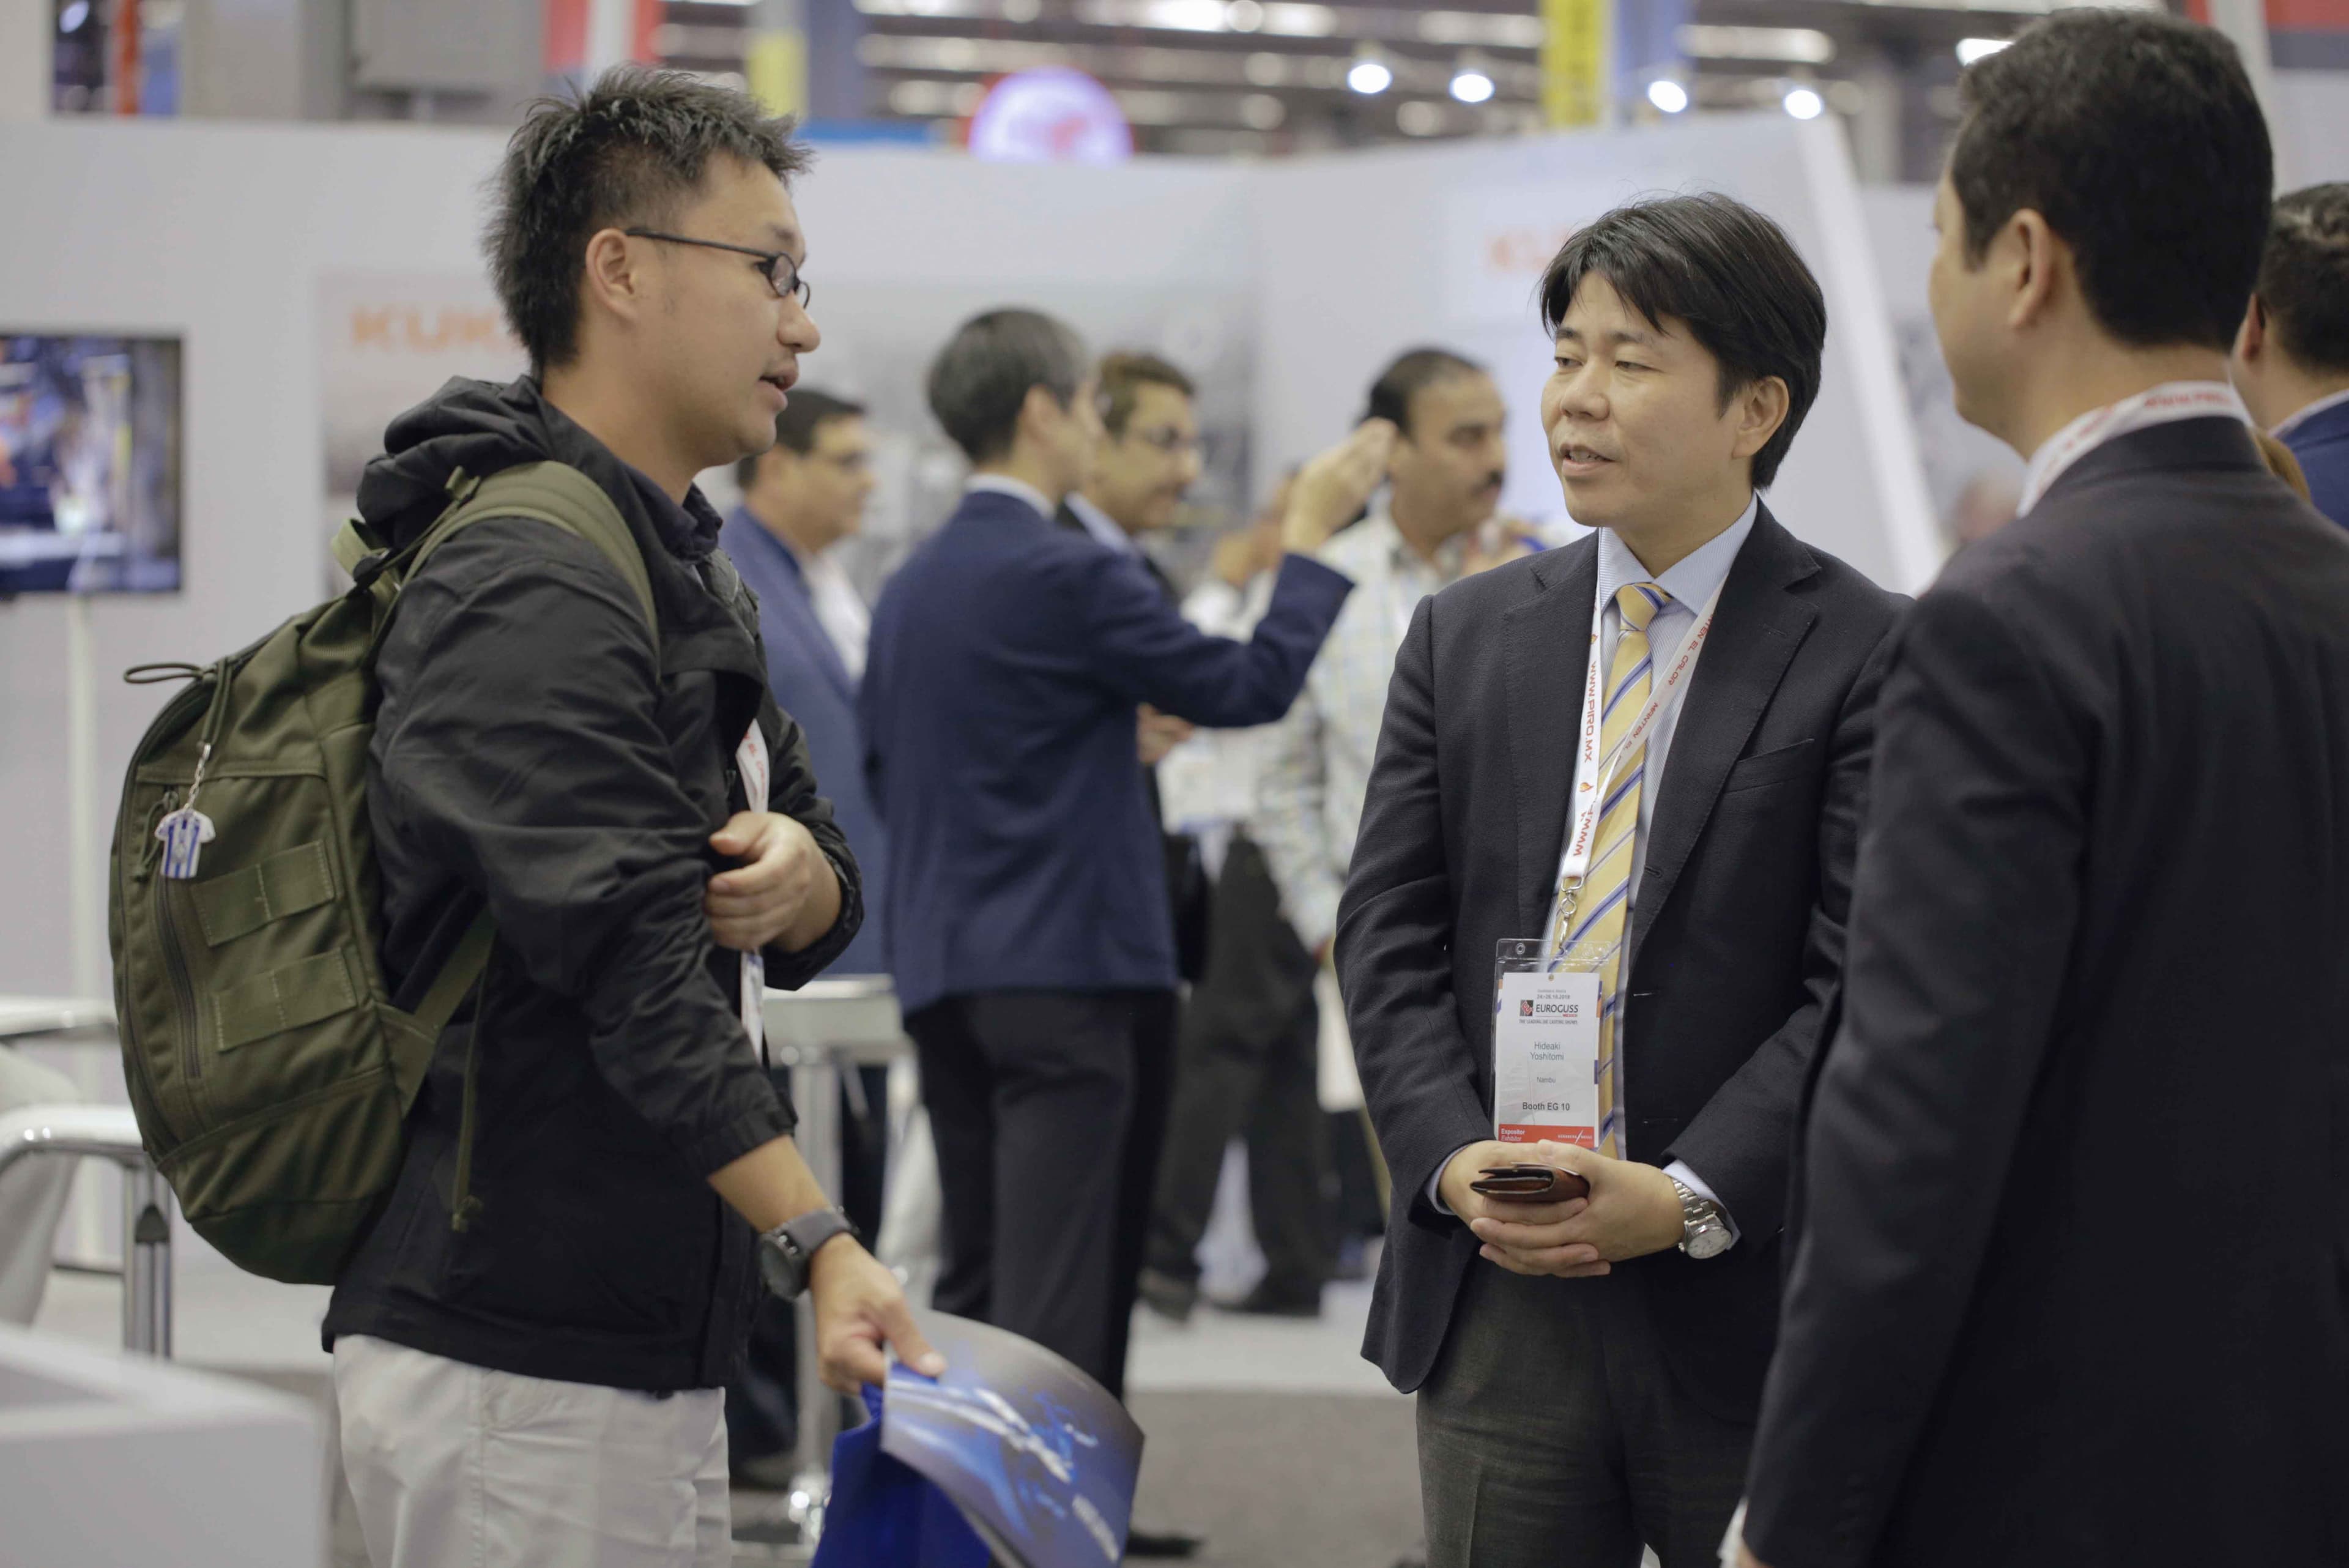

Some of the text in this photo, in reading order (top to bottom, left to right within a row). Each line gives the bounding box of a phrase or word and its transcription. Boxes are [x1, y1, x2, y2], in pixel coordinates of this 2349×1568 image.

[351, 305, 521, 353] KUK
[1668, 614, 1713, 686] NTEN EL CALOR
[1584, 660, 1597, 763] WWW.PIRO.MX
[1633, 702, 1658, 738] MANTEN
[1535, 1004, 1578, 1013] EUROGUSS
[1529, 1052, 1564, 1060] Yoshitomi
[1534, 1042, 1560, 1050] Hideaki
[1522, 1102, 1545, 1110] Booth
[1547, 1102, 1559, 1111] EG
